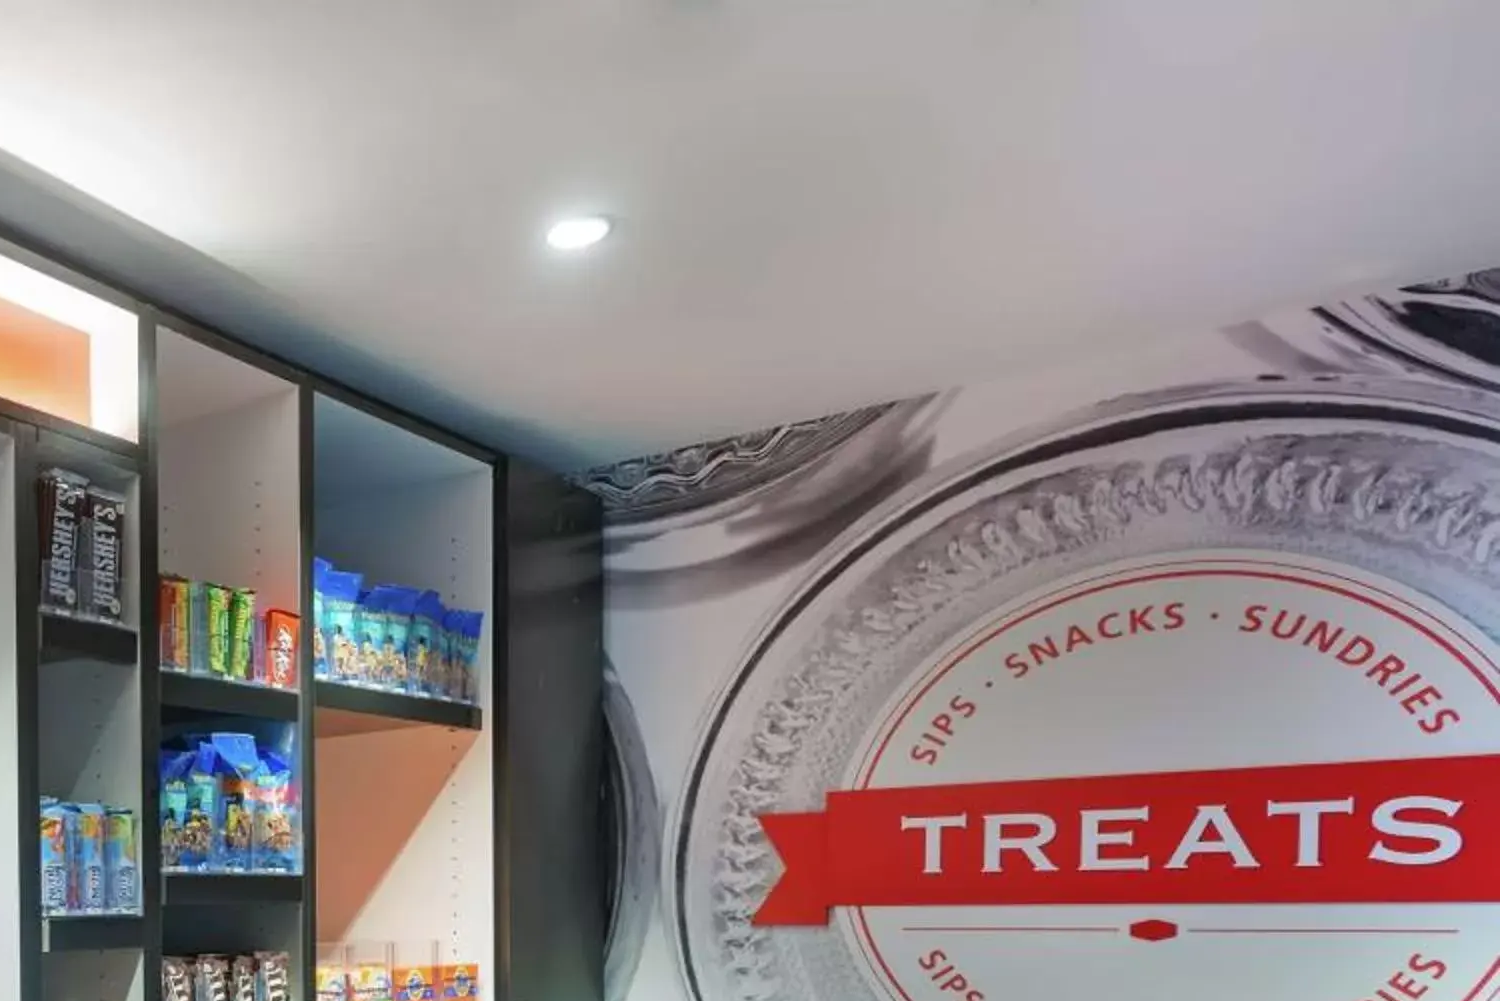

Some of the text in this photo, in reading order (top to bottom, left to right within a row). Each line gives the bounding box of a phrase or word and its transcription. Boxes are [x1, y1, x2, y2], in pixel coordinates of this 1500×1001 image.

[50, 477, 81, 604] HERSHEY'S
[93, 502, 122, 615] HERSHEY'S
[910, 602, 1461, 766] SIPS SNACKS SUNDRIES
[901, 795, 1464, 873] TREATS
